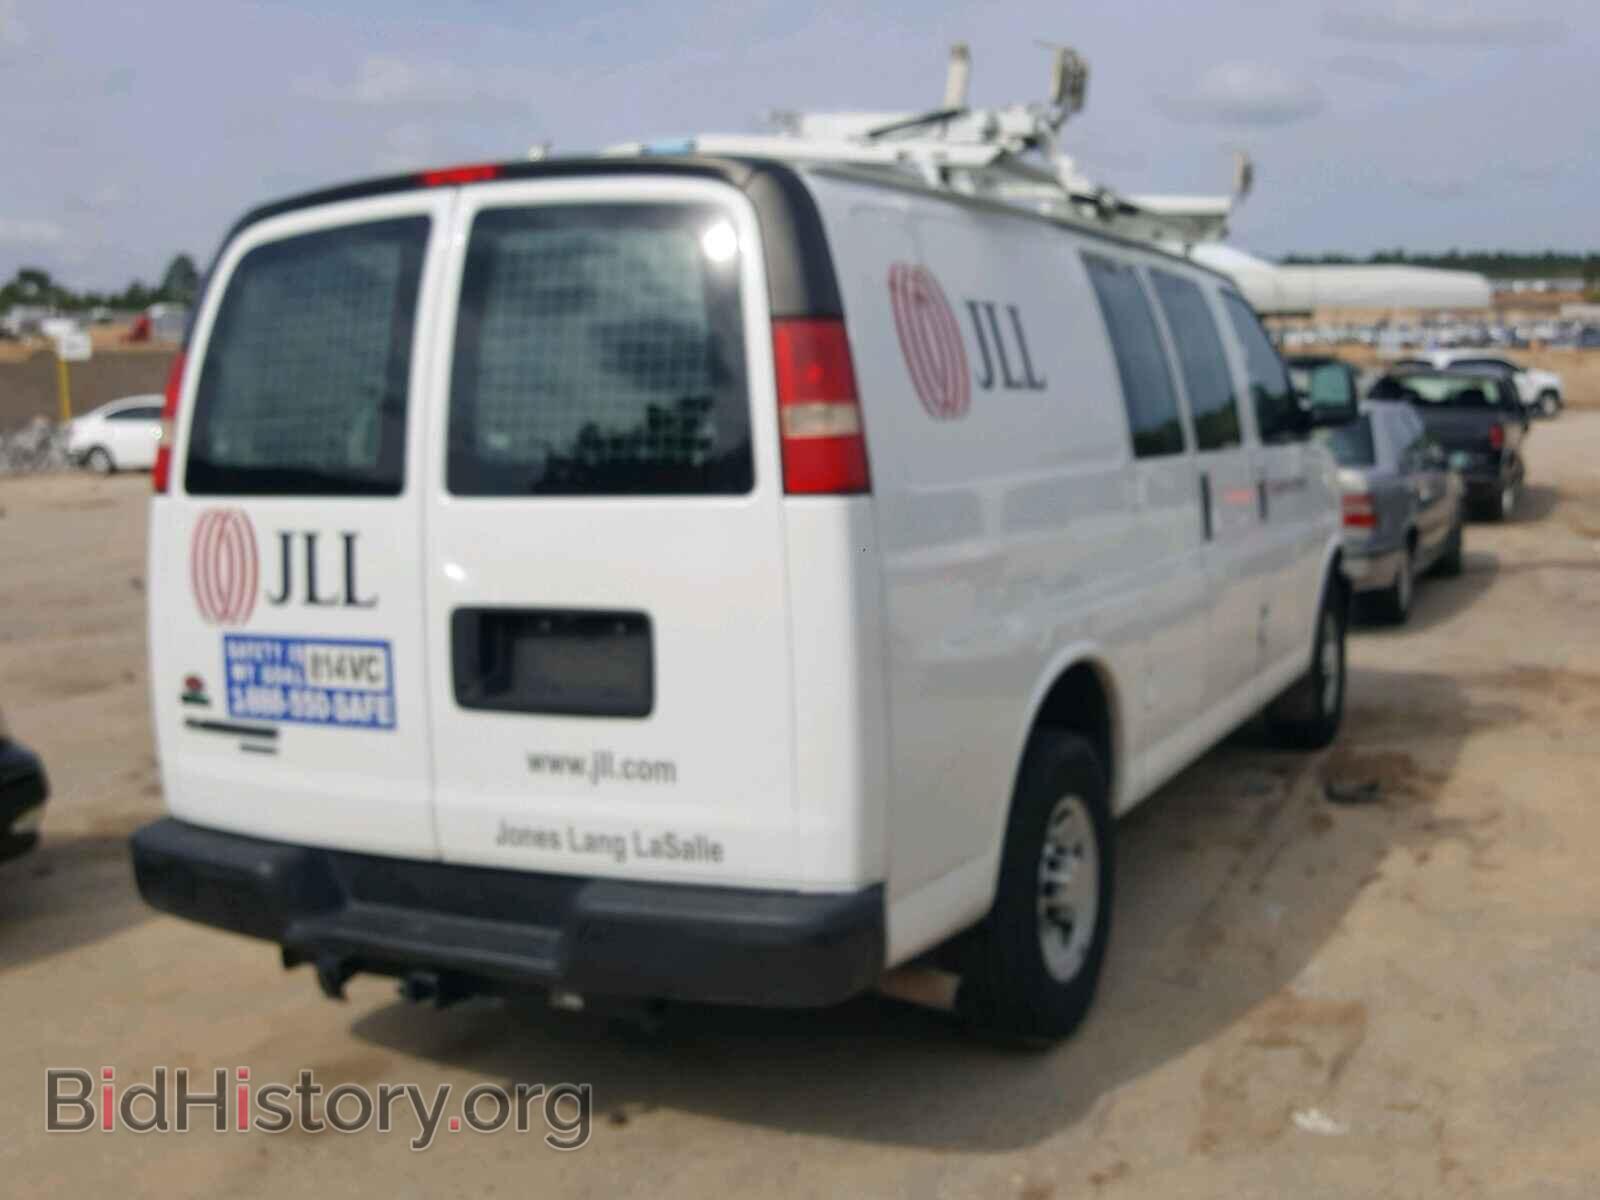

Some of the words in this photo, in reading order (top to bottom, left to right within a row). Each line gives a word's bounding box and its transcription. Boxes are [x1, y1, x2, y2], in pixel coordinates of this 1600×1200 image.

[965, 299, 1048, 390] JLL
[266, 530, 379, 608] JLL
[526, 749, 677, 784] www.jll.com
[496, 819, 562, 850] Jones
[566, 827, 628, 863] Lang
[632, 831, 725, 862] LaSalle
